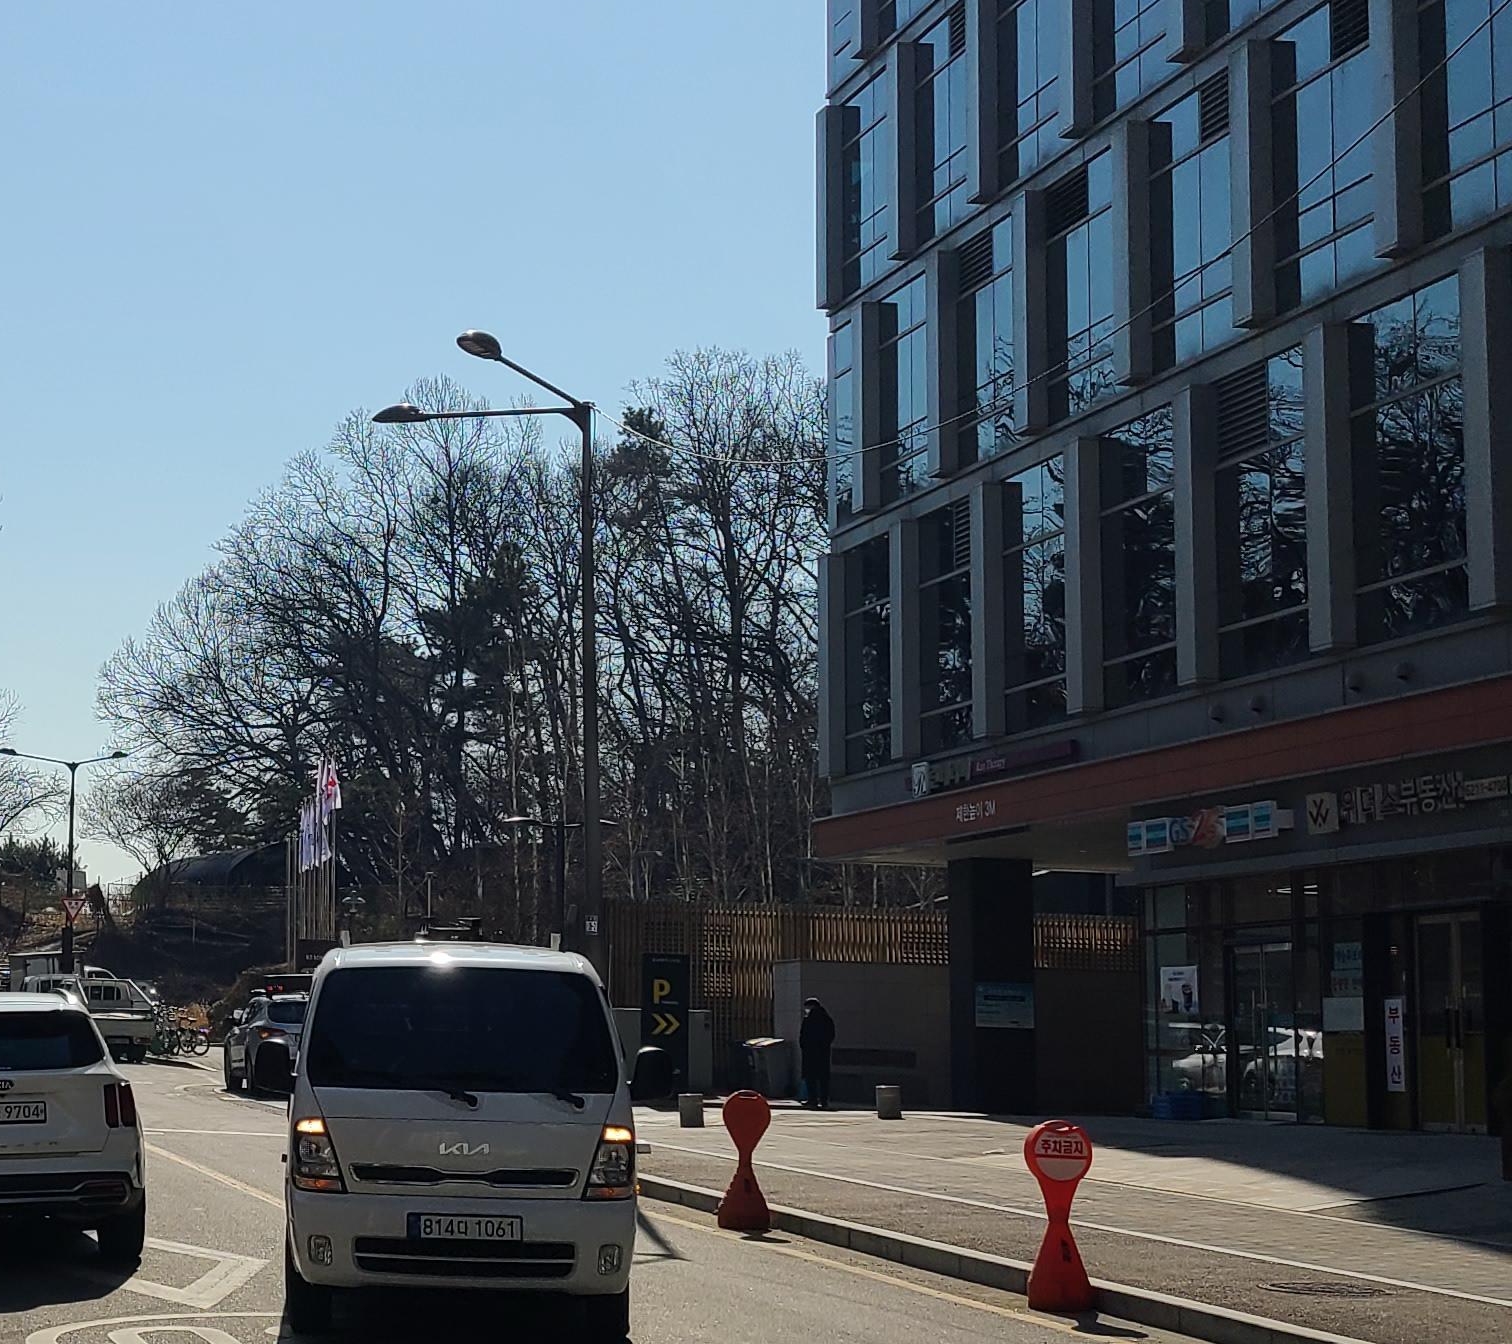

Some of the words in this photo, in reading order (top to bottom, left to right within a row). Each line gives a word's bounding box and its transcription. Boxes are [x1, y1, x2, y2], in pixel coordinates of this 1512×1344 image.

[955, 800, 983, 823] 제한높이
[985, 799, 996, 817] 3M
[652, 978, 672, 1005] P
[1388, 1007, 1402, 1084] 부동산
[4, 1105, 40, 1119] 9704
[439, 1142, 490, 1155] KIA
[1040, 1139, 1084, 1155] 주차금지
[475, 1219, 515, 1238] 1061
